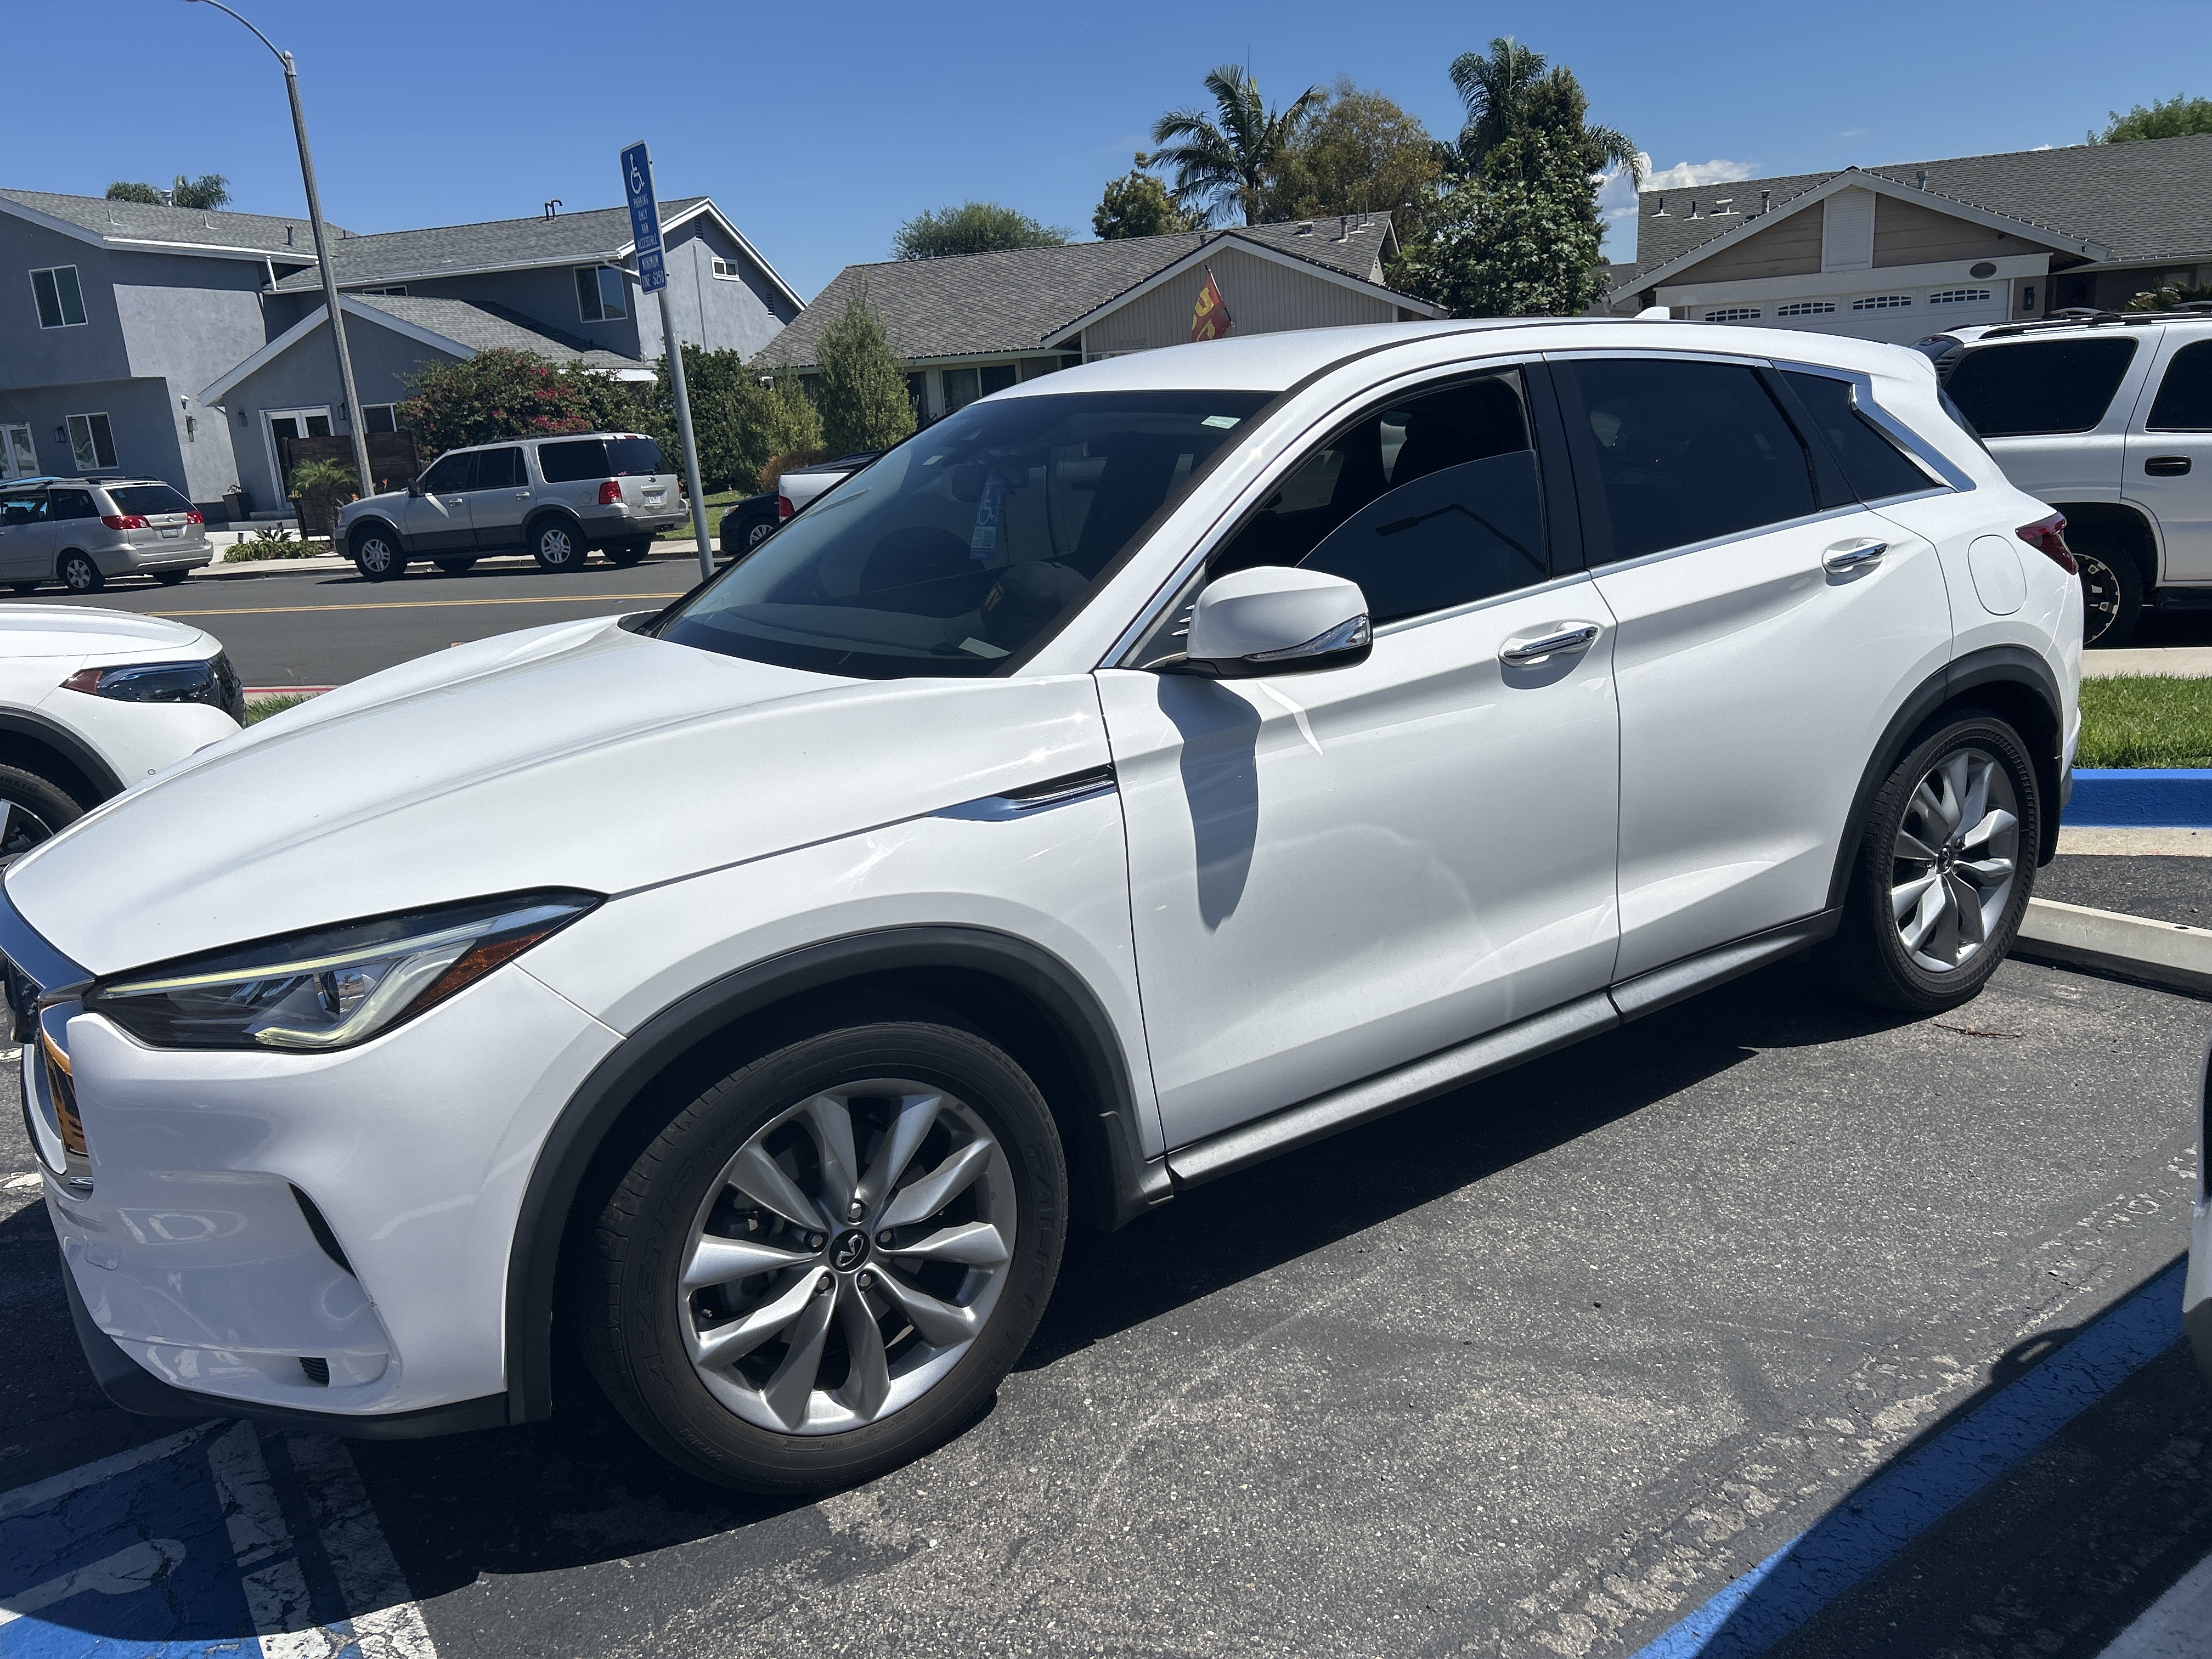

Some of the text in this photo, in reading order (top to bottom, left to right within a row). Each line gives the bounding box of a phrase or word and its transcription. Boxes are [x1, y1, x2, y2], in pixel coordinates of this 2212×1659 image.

[633, 193, 649, 209] PARKING
[638, 208, 648, 221] ONLY
[641, 222, 650, 234] VAN
[637, 233, 658, 250] ACCESSIBLE
[641, 253, 659, 270] MINIMUM
[641, 274, 651, 289] FINE
[652, 269, 664, 285] $250
[636, 1156, 696, 1395] AZENIS
